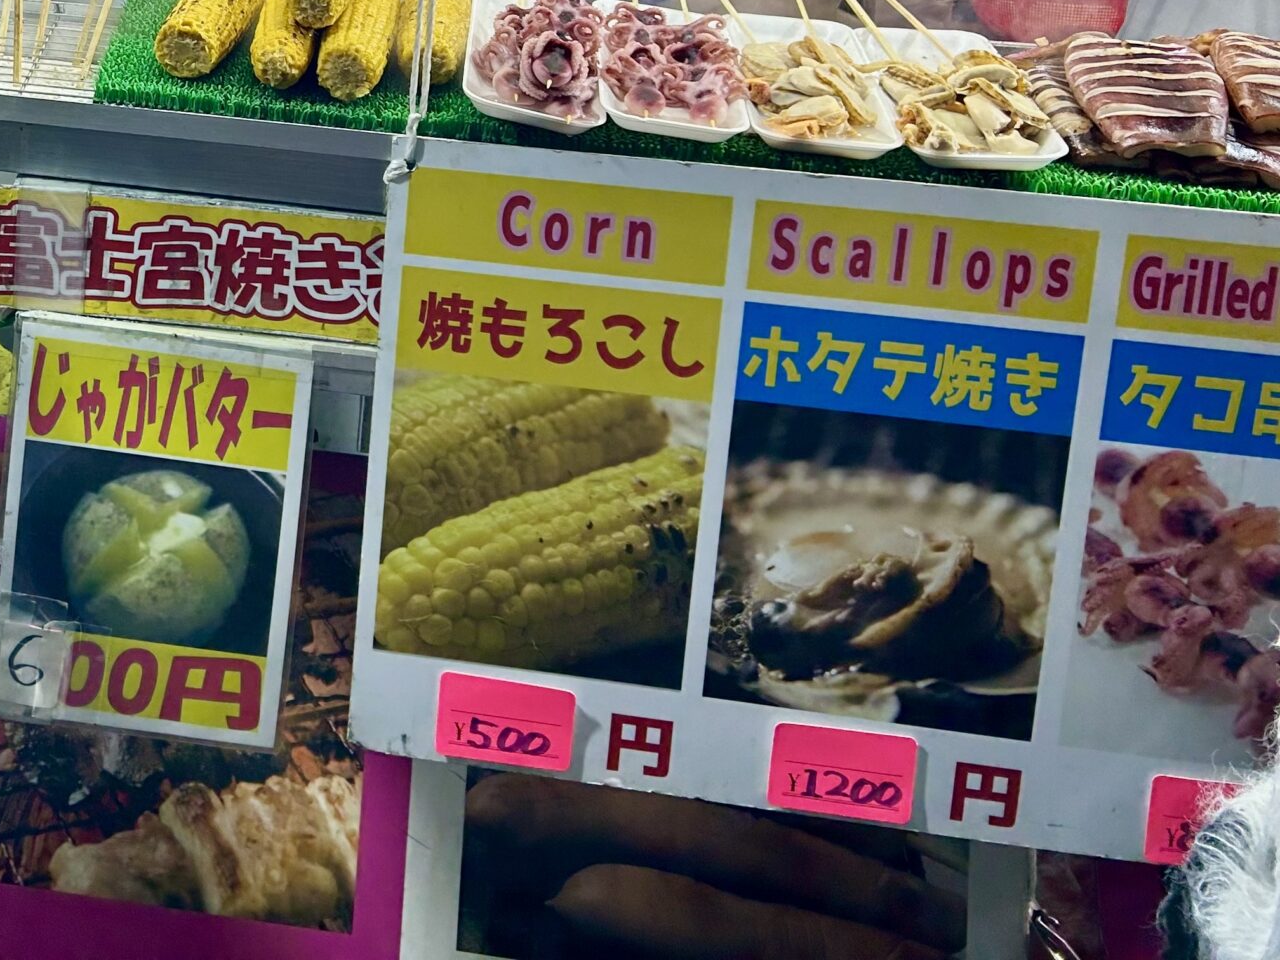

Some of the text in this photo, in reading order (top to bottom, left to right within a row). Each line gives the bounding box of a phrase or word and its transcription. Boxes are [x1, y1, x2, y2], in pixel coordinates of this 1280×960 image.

[499, 193, 656, 262] Corn
[769, 217, 1075, 307] Scallops
[1132, 255, 1278, 322] Grilled
[416, 290, 706, 379] 焼もろこし
[743, 324, 1060, 417] ホタテ焼き
[28, 341, 294, 461] じゃがバター
[606, 712, 674, 778] 円
[949, 761, 1022, 828] 円
